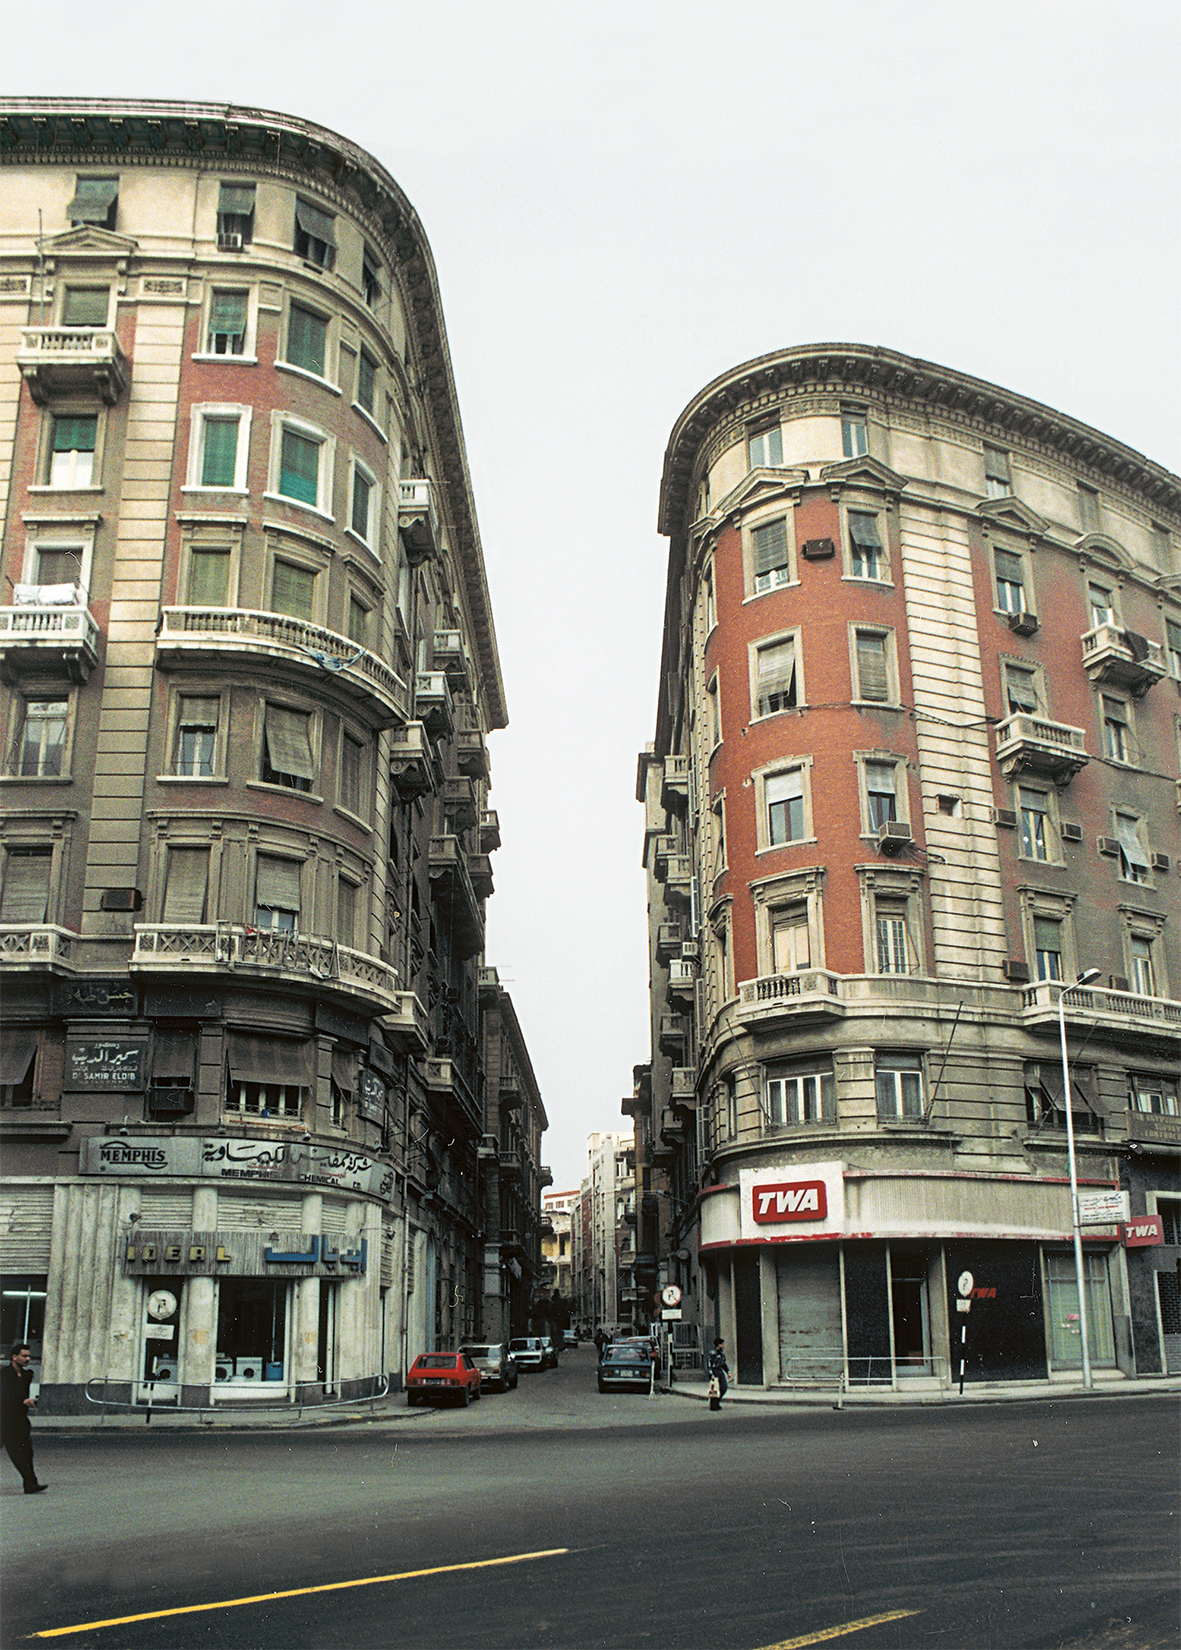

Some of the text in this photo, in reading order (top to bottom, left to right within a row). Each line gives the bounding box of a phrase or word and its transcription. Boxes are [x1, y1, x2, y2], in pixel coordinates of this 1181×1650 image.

[101, 1150, 167, 1161] MEMPHIS
[221, 1168, 279, 1179] MEMPHIS
[298, 1173, 341, 1186] CHEMICAL
[758, 1188, 819, 1214] TWA
[1125, 1224, 1158, 1240] TWA
[127, 1245, 232, 1262] IDEAL
[970, 1287, 997, 1299] TWA
